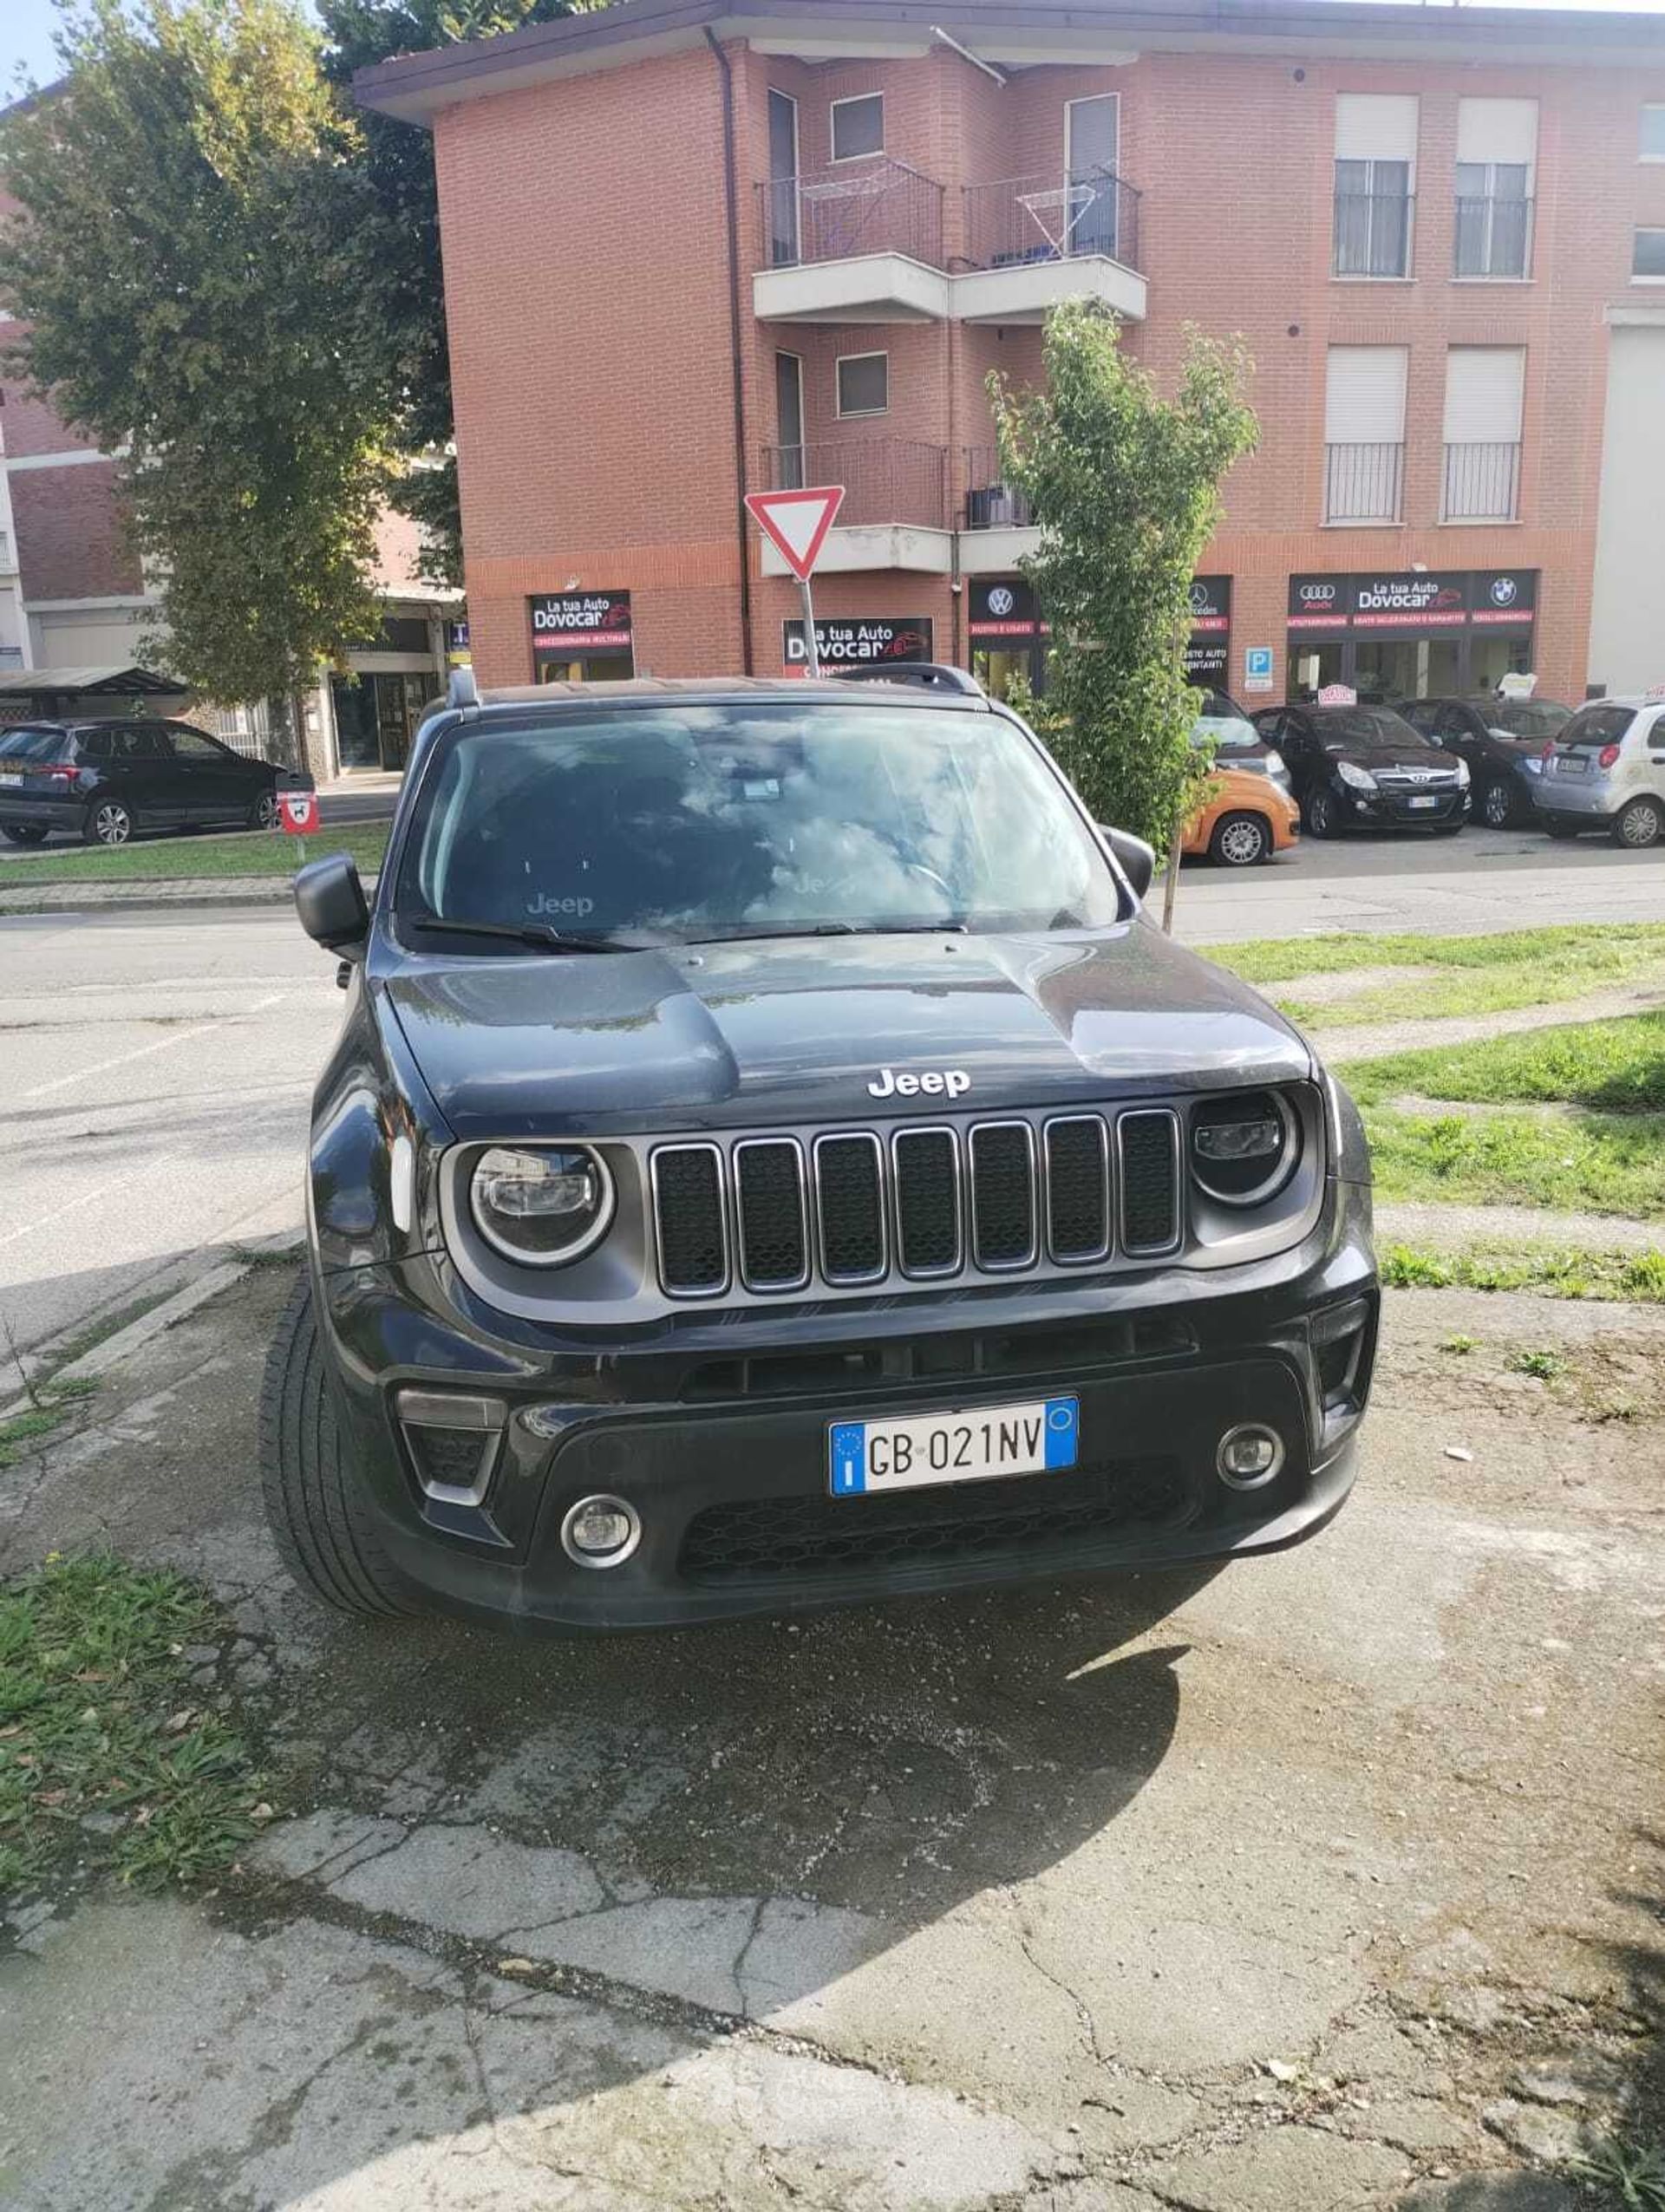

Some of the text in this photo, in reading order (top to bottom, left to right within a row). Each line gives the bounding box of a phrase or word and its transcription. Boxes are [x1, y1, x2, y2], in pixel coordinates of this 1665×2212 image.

[1374, 582, 1439, 595] La tua Auto
[547, 597, 610, 612] La tua Auto
[1359, 591, 1430, 609] Dovocar
[534, 610, 604, 629] Dovocar
[829, 626, 853, 641] tua
[857, 625, 893, 641] Auto
[1252, 652, 1265, 671] P
[526, 892, 594, 917] Jeep
[866, 1068, 971, 1099] Jeep
[870, 1417, 1041, 1477] GB 021NV
